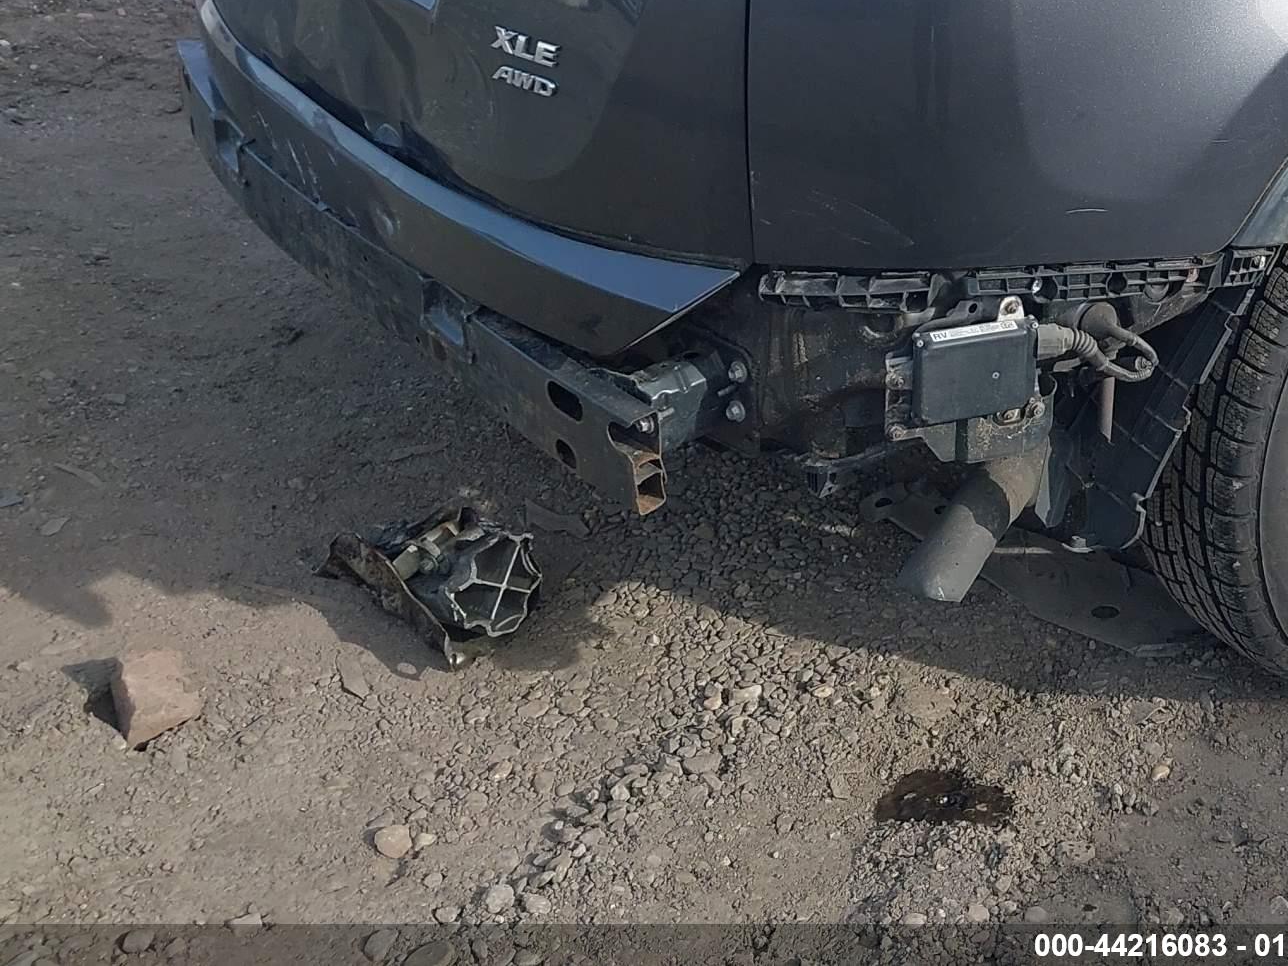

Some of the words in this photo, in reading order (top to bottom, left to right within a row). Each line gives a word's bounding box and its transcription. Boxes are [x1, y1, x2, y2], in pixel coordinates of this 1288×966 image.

[491, 25, 561, 66] XLE
[492, 66, 556, 97] AWD
[933, 331, 947, 341] RV
